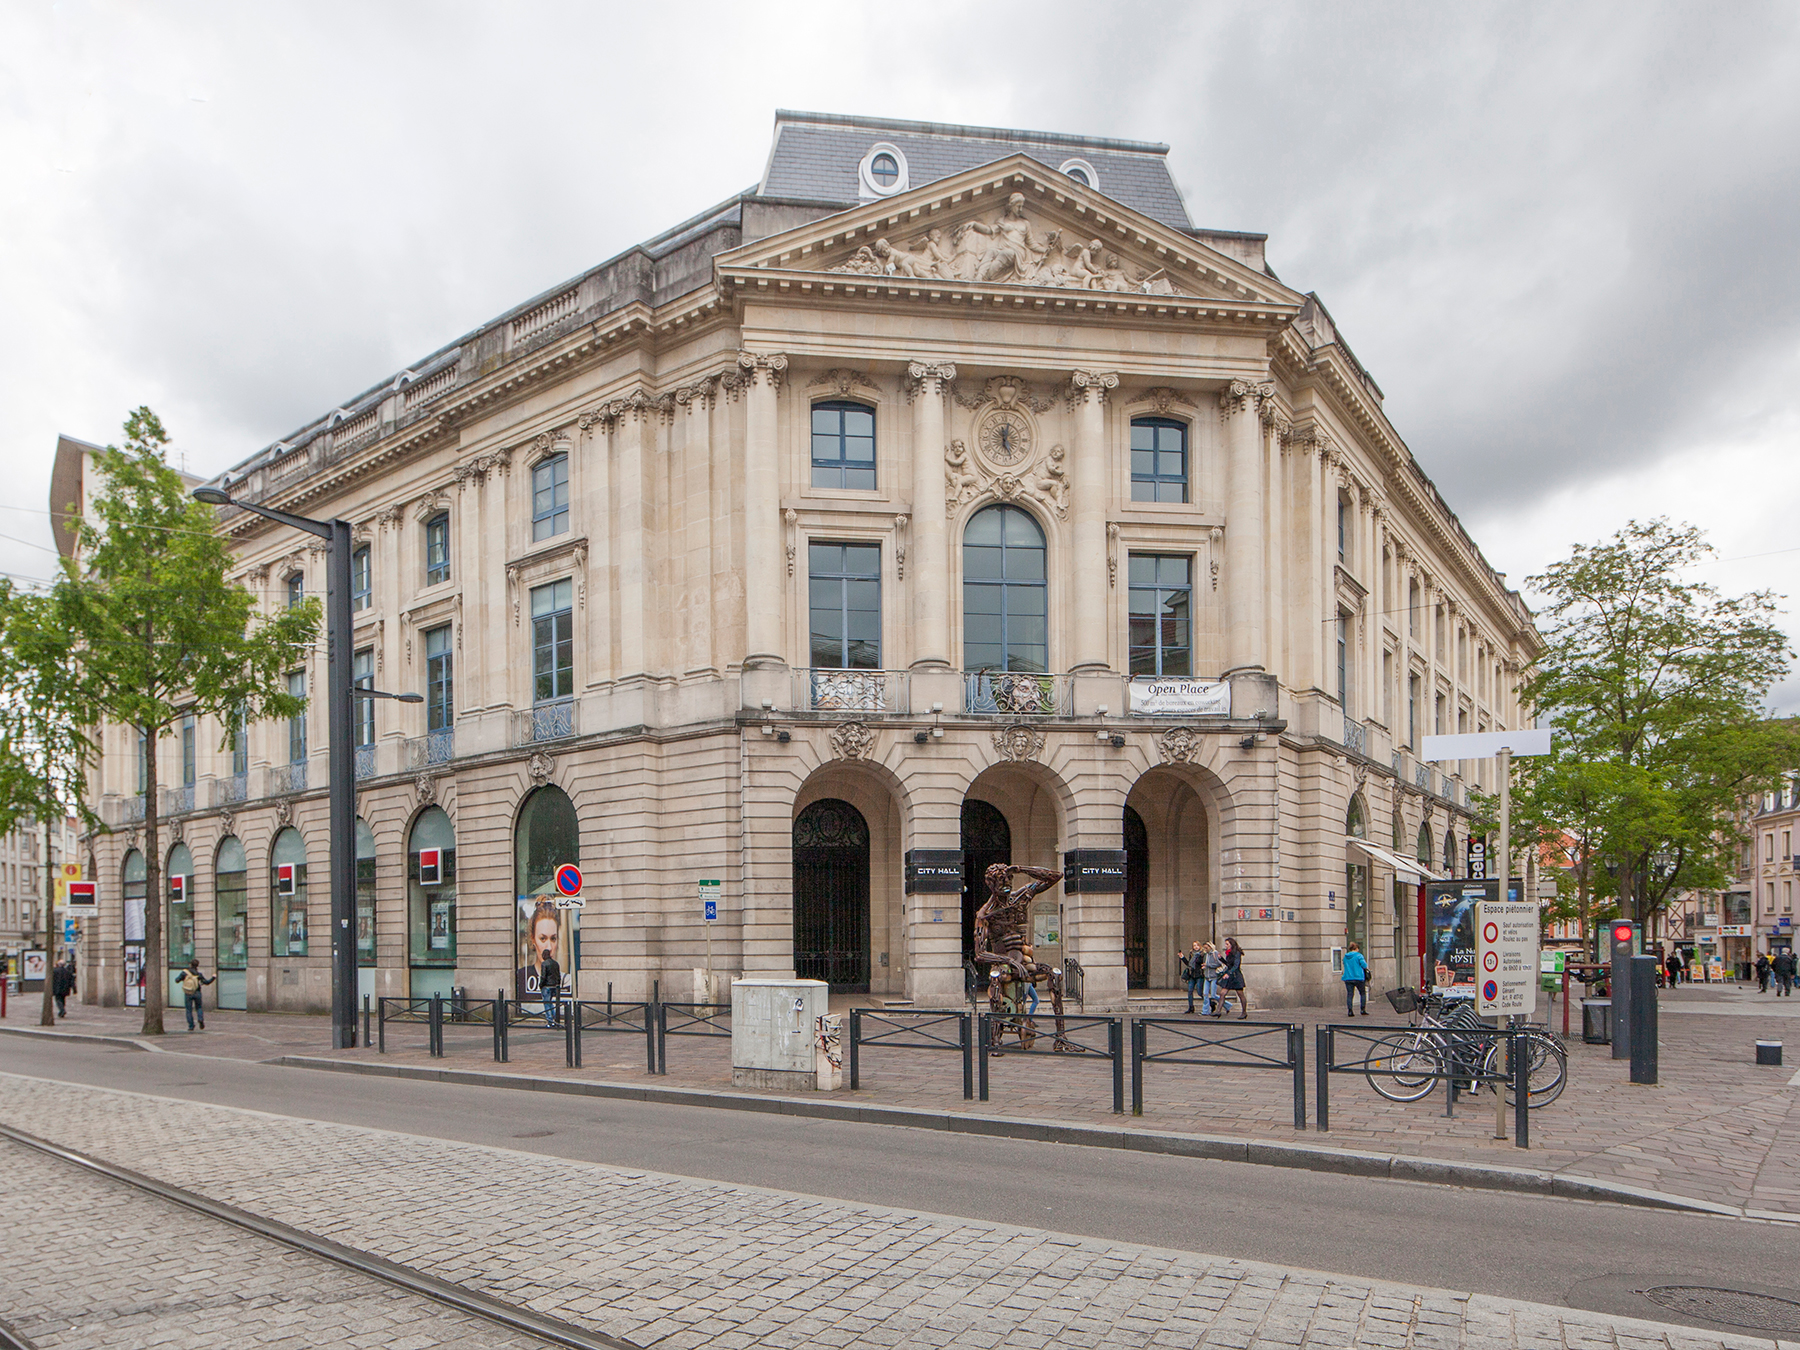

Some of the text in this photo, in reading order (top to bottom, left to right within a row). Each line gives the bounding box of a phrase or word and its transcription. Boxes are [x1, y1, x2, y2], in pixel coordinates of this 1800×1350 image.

[1148, 683, 1209, 696] Open Place
[1469, 843, 1484, 879] celio
[1484, 905, 1534, 915] Espace piétonnier
